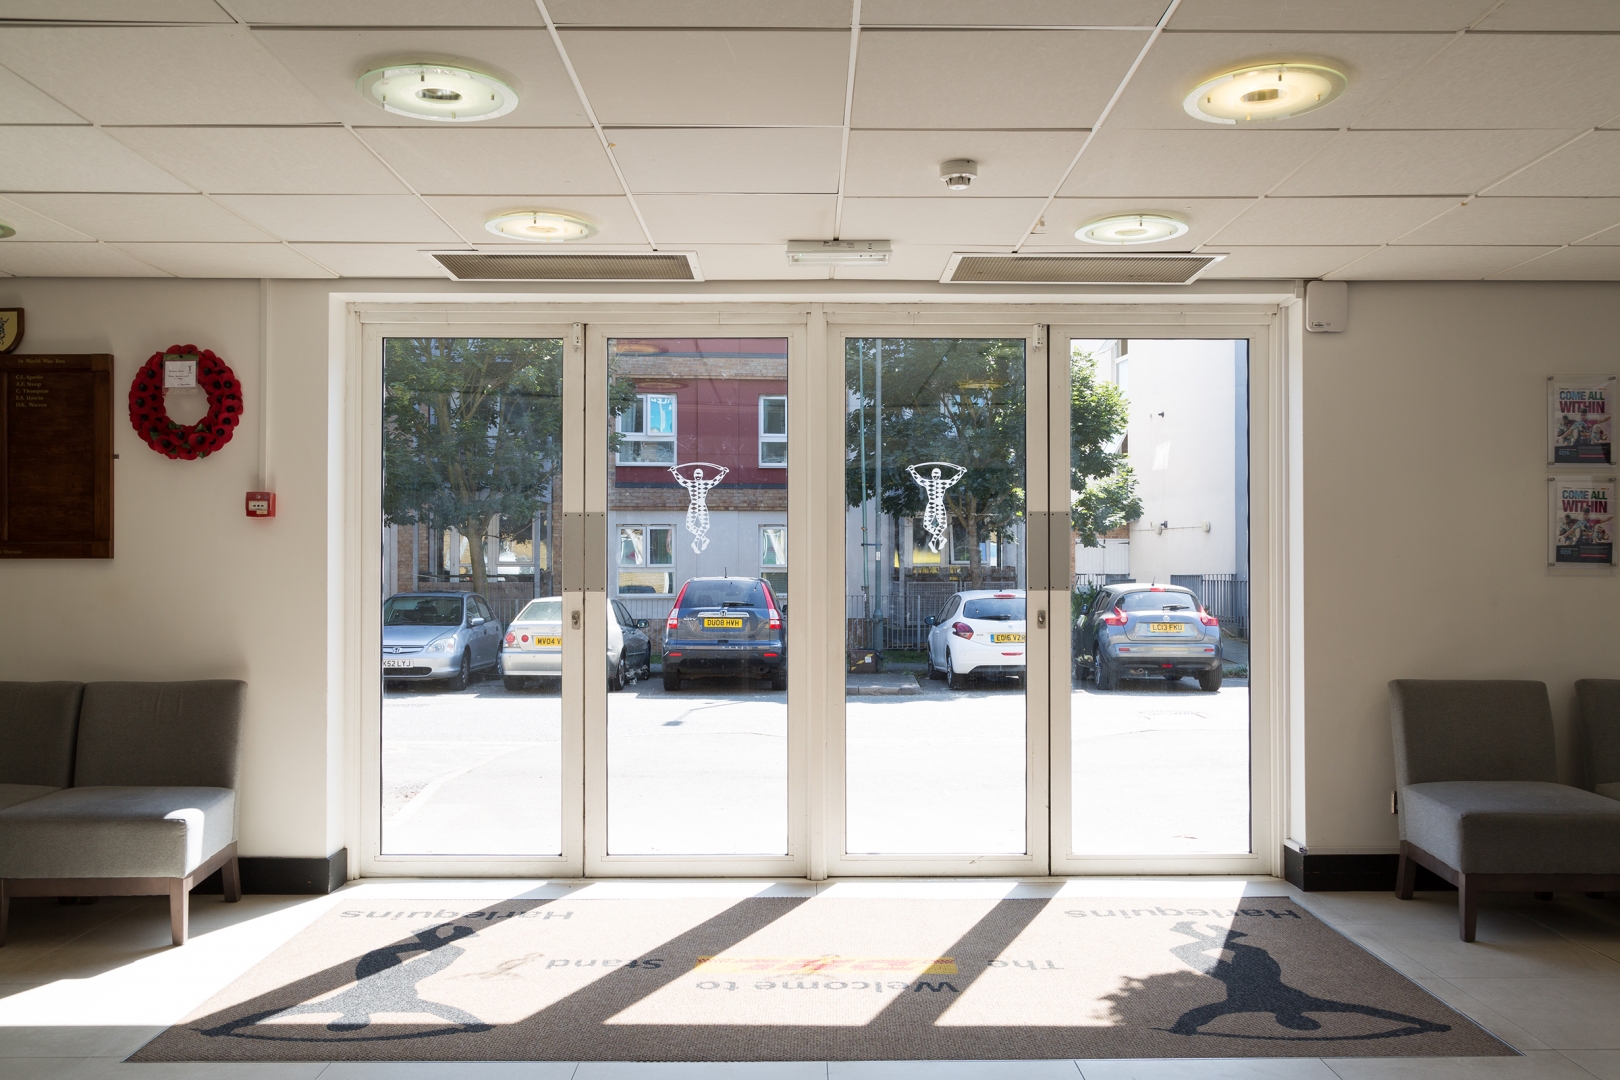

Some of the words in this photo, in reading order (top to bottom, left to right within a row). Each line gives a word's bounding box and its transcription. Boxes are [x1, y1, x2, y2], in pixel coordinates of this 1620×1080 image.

[1560, 391, 1586, 400] COME
[1588, 391, 1605, 400] ALL
[1559, 401, 1605, 413] WITHIN
[1562, 490, 1589, 499] COME
[1591, 490, 1607, 500] ALL
[1562, 500, 1607, 513] WITHIN
[340, 909, 574, 920] Harlequins
[1064, 907, 1302, 920] Harlequins
[546, 959, 664, 970] Stand
[987, 960, 1064, 970] The
[695, 981, 738, 992] to
[754, 981, 959, 993] Welcome
